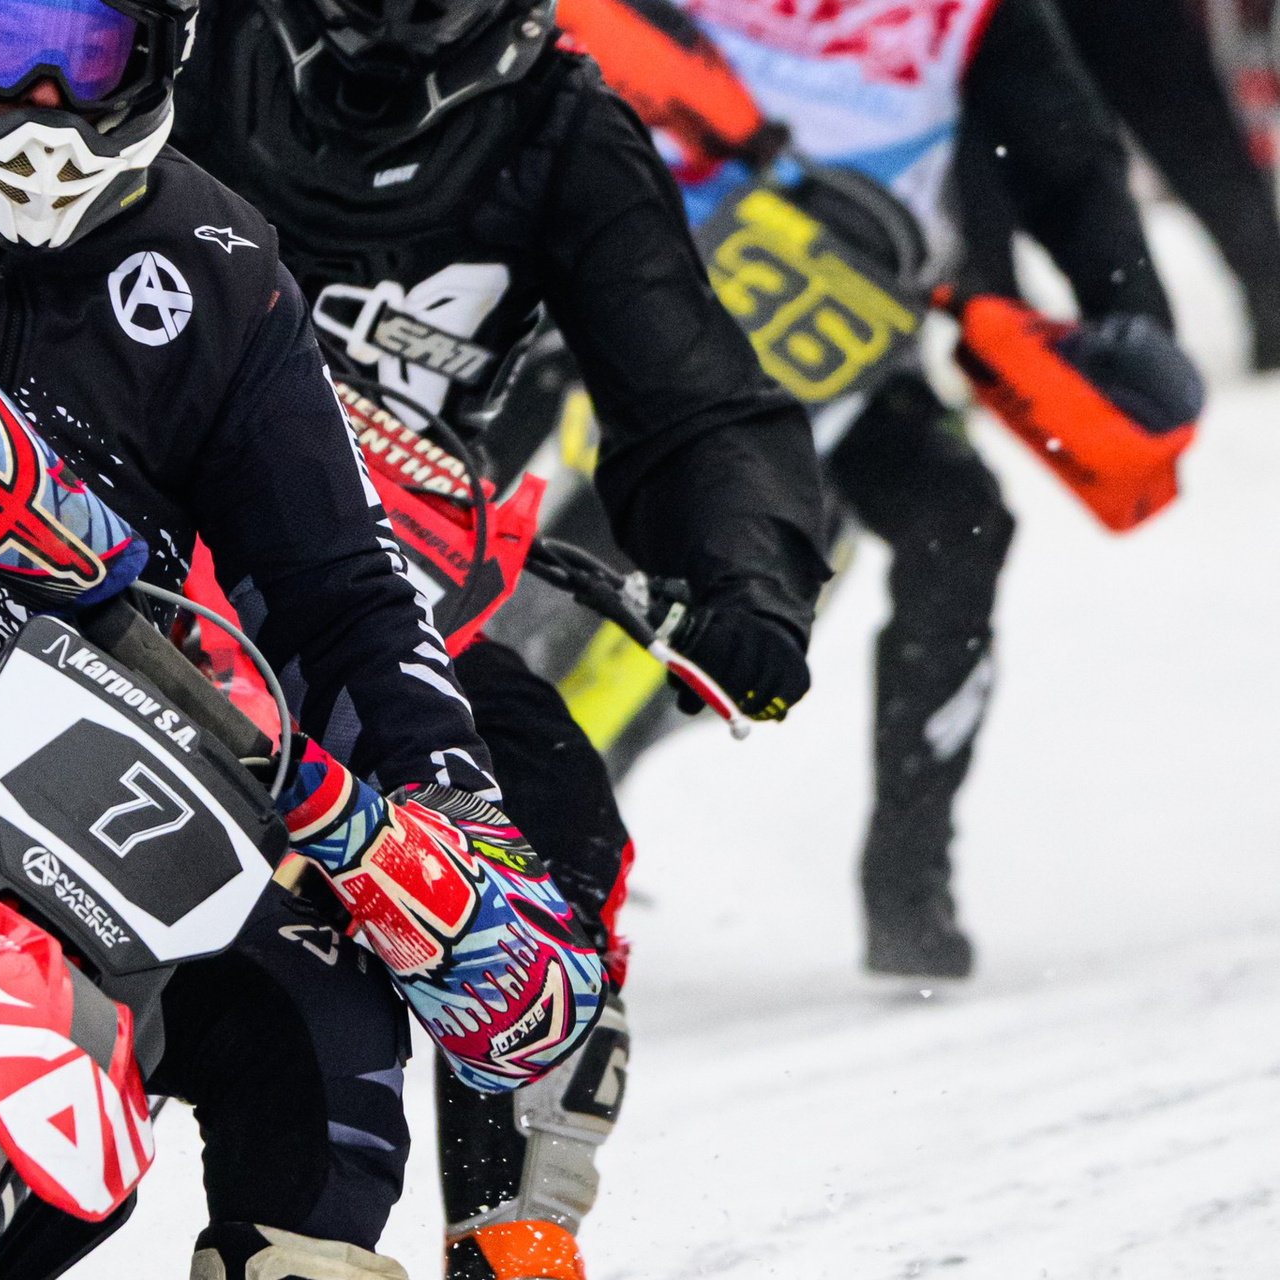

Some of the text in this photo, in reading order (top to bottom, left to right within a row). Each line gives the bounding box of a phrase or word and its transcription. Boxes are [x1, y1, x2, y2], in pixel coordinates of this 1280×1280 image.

[66, 646, 196, 752] Karpov S.A.
[89, 760, 195, 858] 7
[51, 883, 116, 949] RACING
